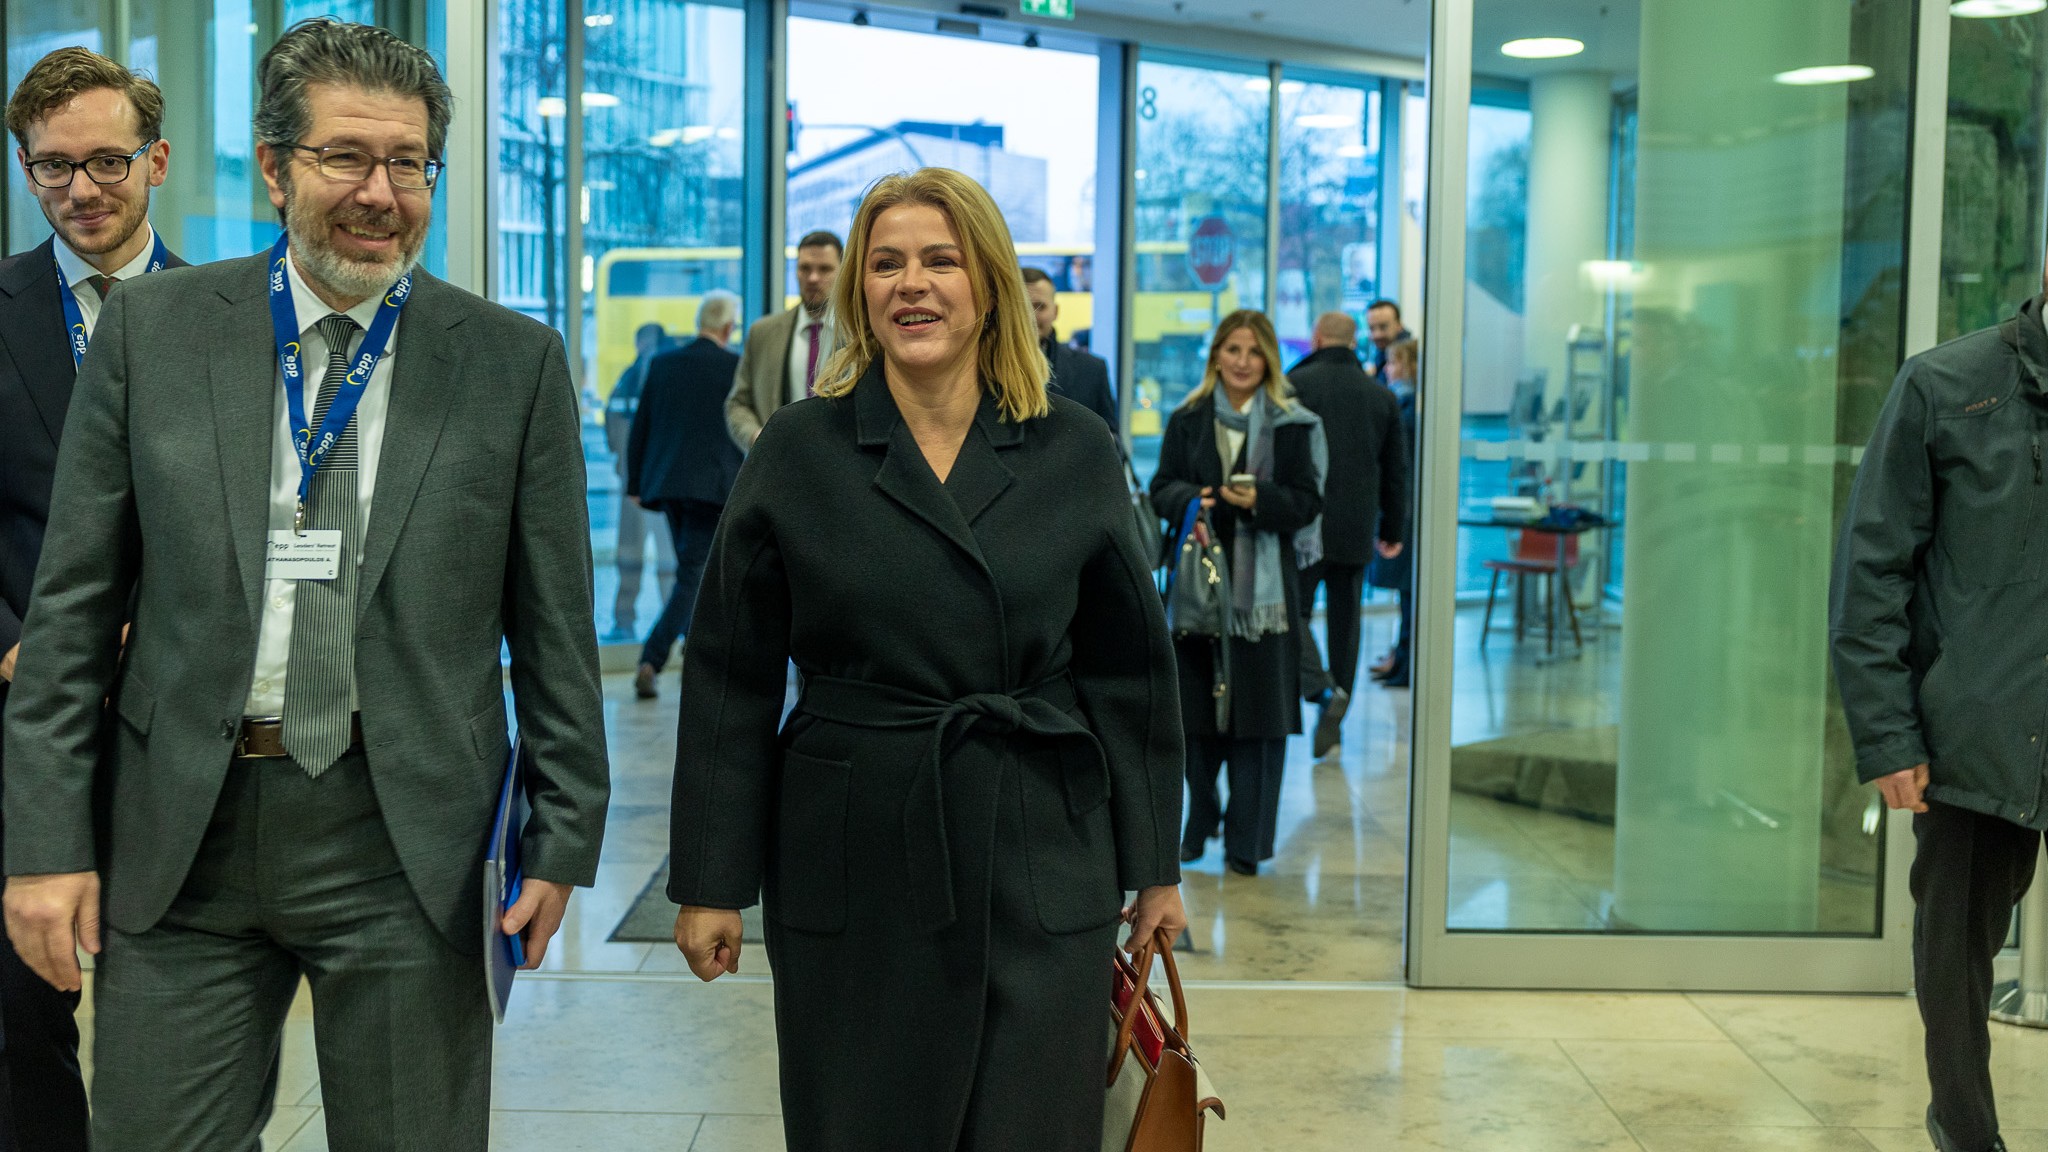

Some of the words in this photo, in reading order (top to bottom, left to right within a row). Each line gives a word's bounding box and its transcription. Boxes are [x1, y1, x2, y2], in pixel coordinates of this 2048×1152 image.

[1141, 87, 1157, 120] 8
[272, 270, 285, 292] epp
[394, 276, 410, 297] epp
[76, 334, 87, 354] epp
[286, 355, 299, 378] epp
[355, 353, 373, 376] epp
[317, 432, 334, 454] epp
